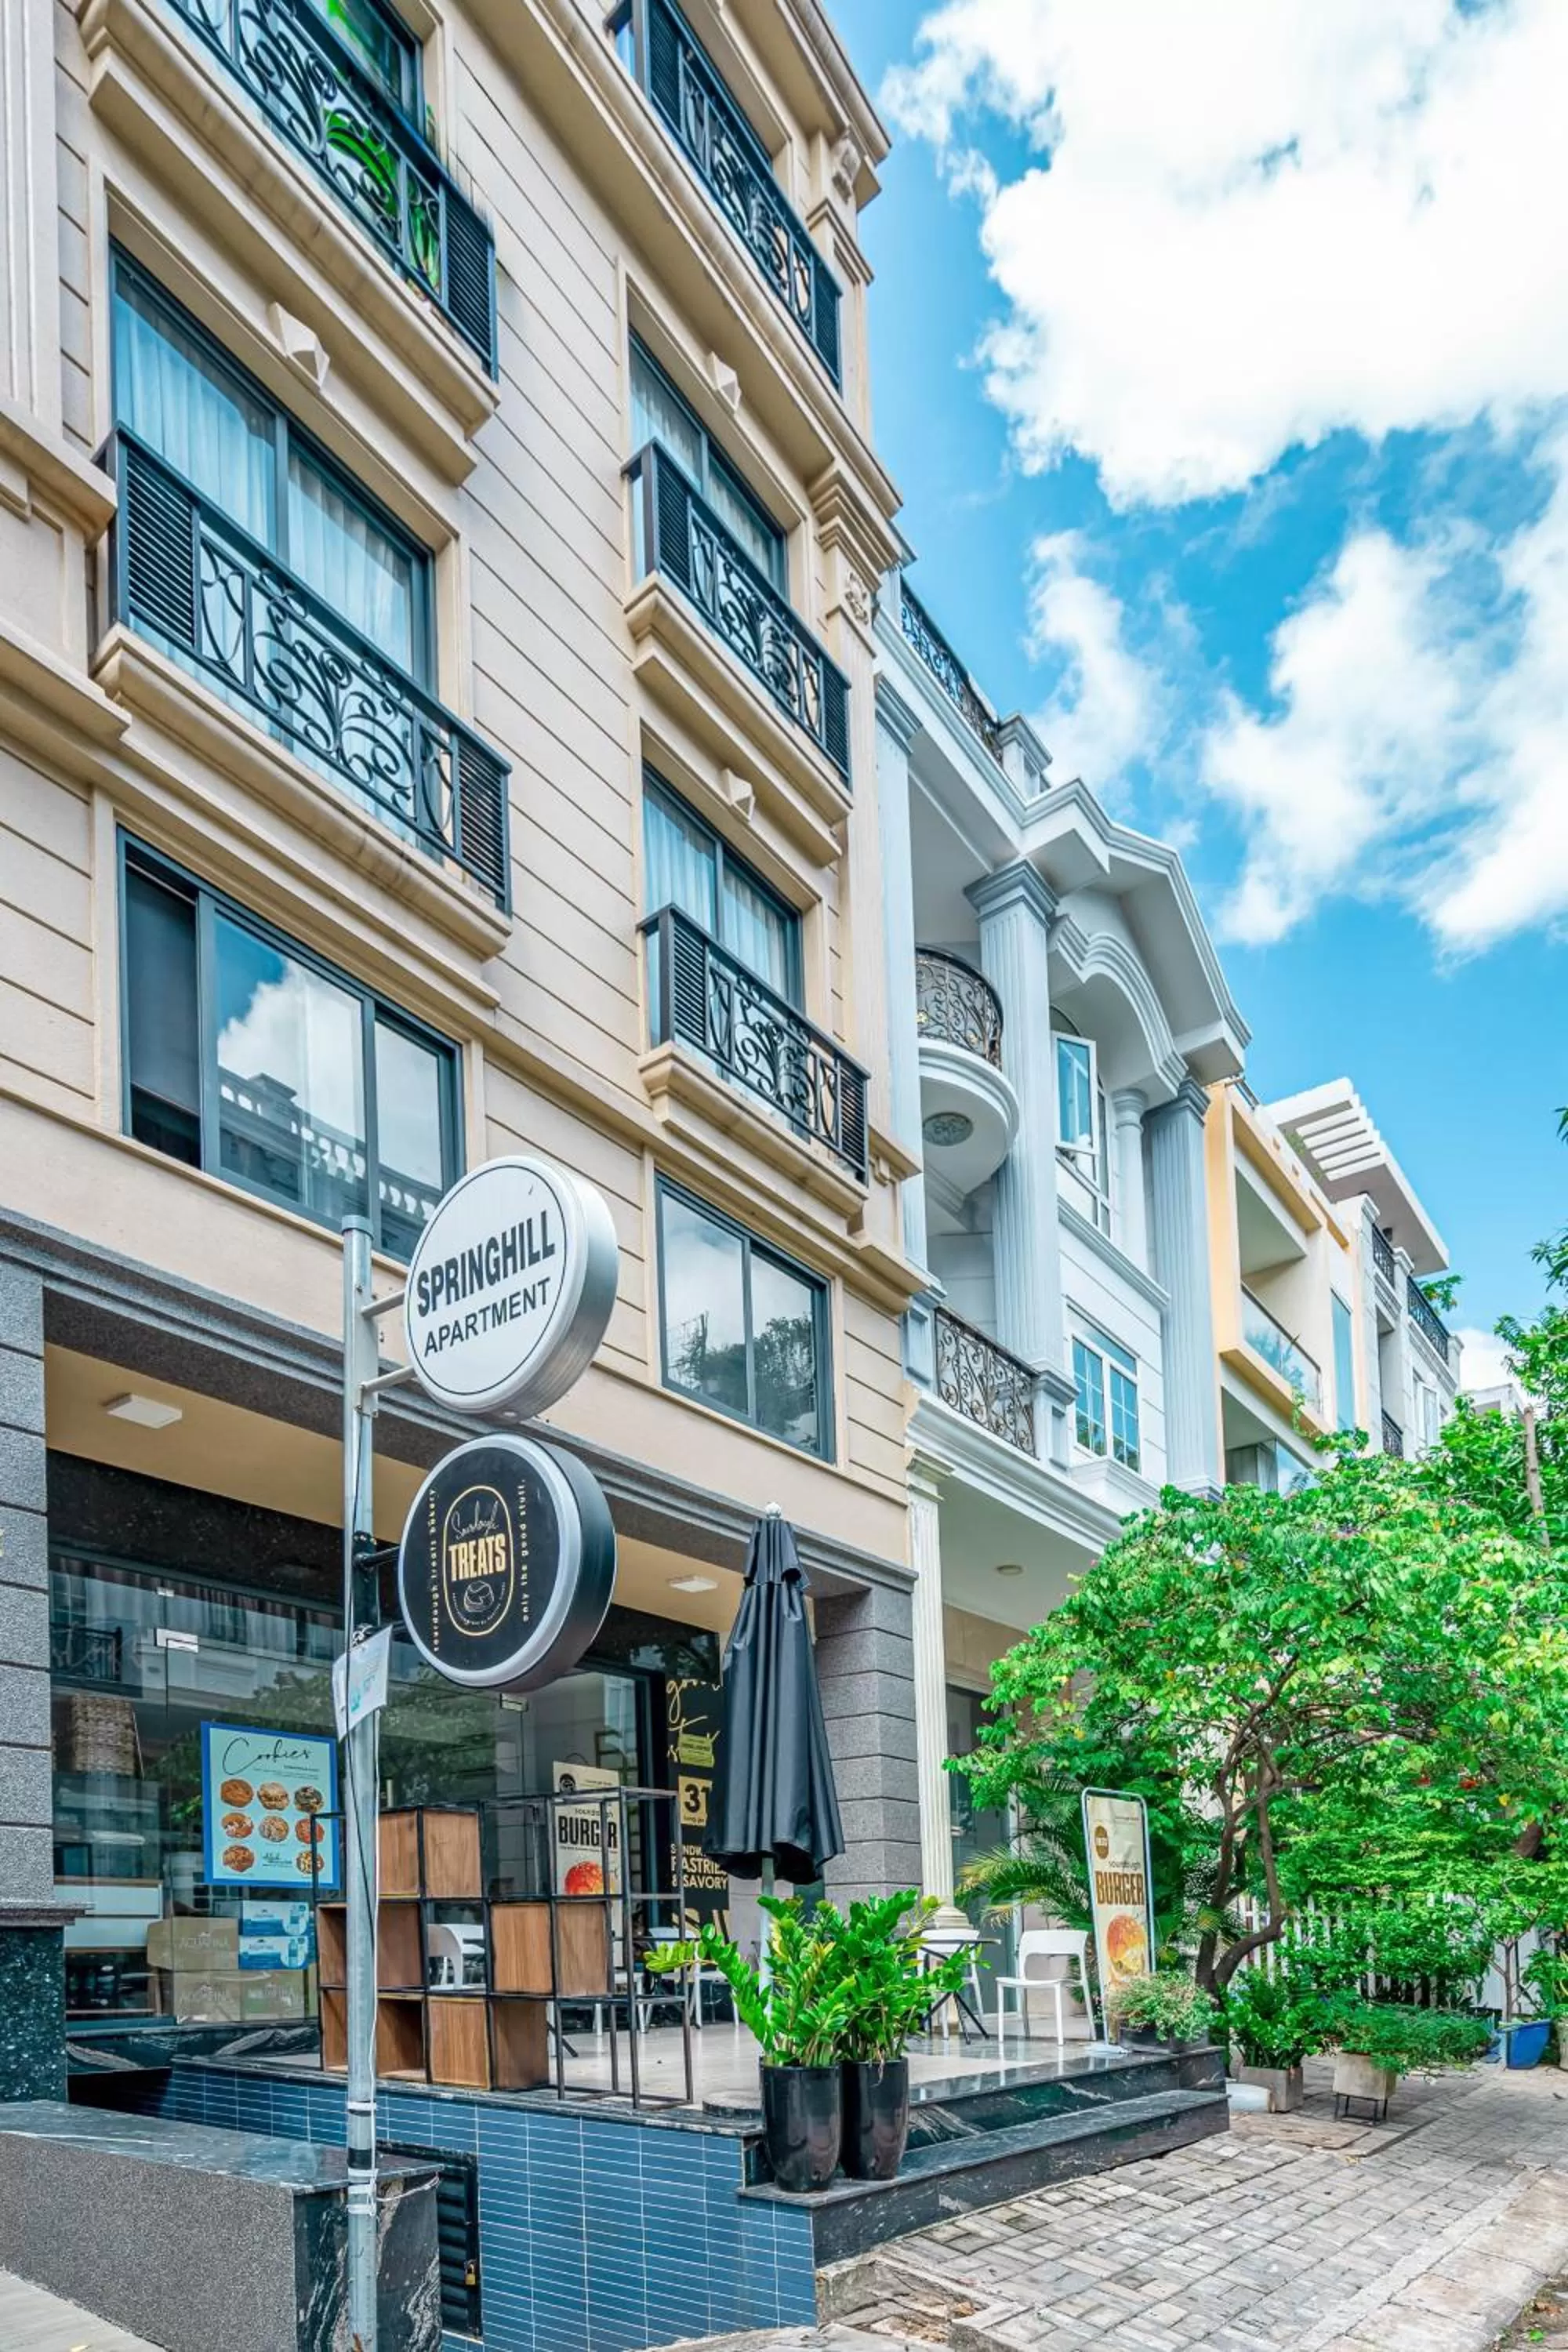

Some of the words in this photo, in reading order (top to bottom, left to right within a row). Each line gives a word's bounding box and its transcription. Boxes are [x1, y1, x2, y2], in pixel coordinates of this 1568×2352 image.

[416, 1210, 555, 1317] SPRINGHILL
[424, 1276, 550, 1357] APARTMENT
[519, 1523, 529, 1557] good
[448, 1533, 506, 1582] TREATS
[521, 1593, 529, 1622] only
[222, 1737, 311, 1776] Cookies
[557, 1815, 618, 1849] BURGR
[670, 1856, 727, 1876] PASTRIE
[682, 1875, 728, 1889] SAVORY
[1094, 1871, 1145, 1905] BURGER
